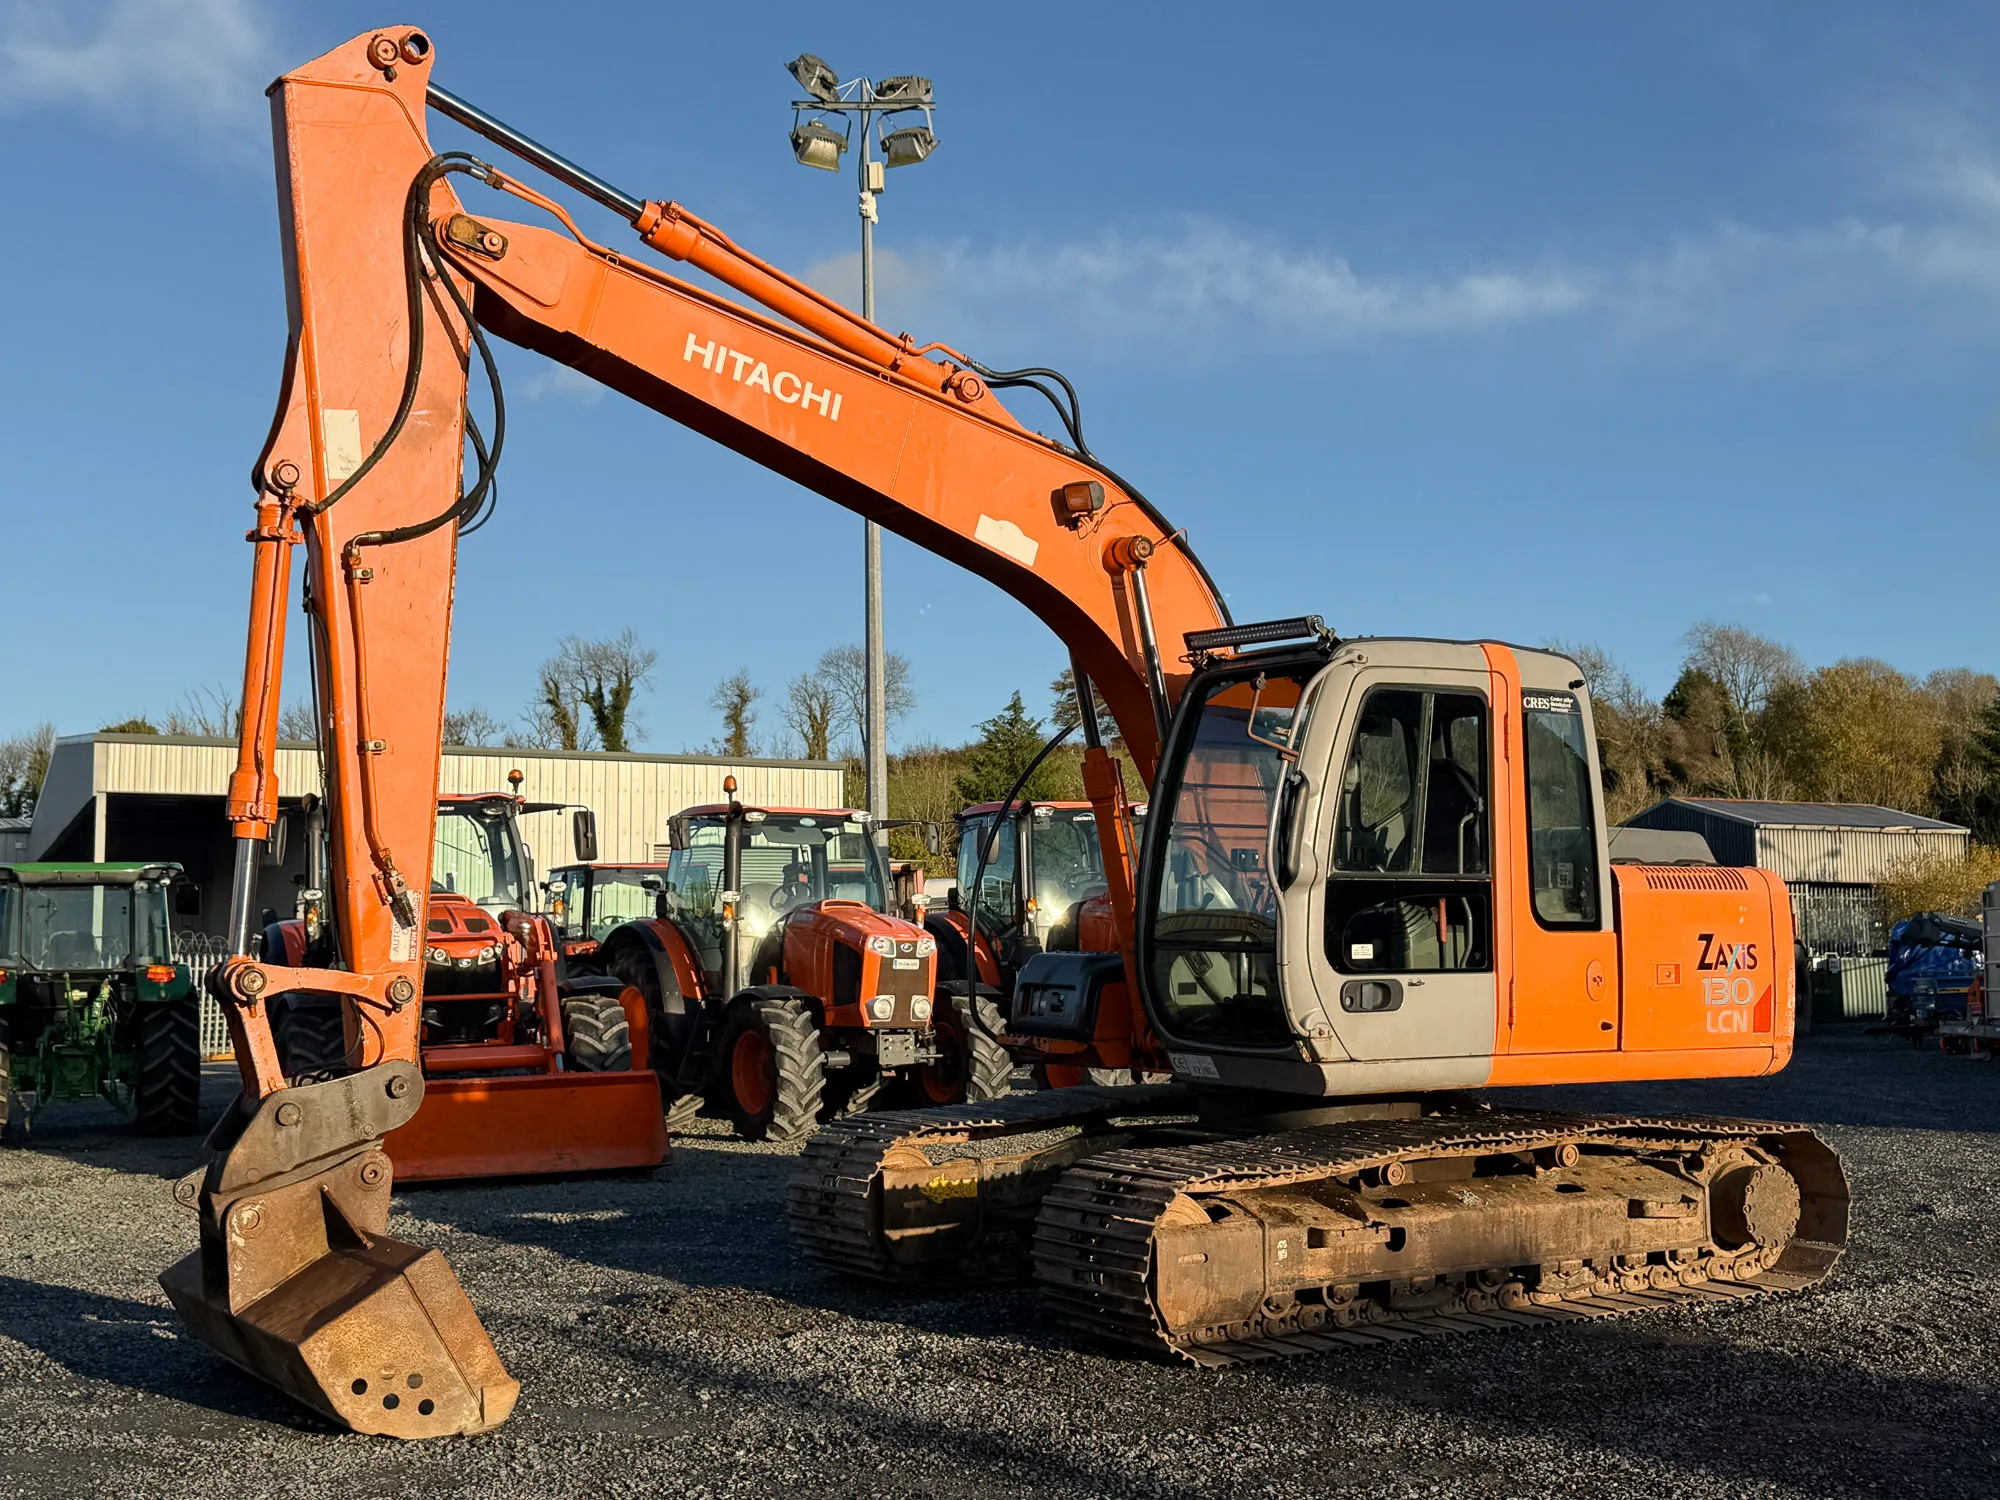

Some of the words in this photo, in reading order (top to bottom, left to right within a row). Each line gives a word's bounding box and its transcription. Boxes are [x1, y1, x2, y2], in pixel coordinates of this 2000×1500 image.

[683, 332, 843, 422] HITACHI
[1523, 696, 1550, 709] CRES
[410, 931, 418, 947] PIN
[409, 948, 416, 960] NO
[1702, 977, 1754, 1006] 130
[1706, 1010, 1748, 1033] LCN
